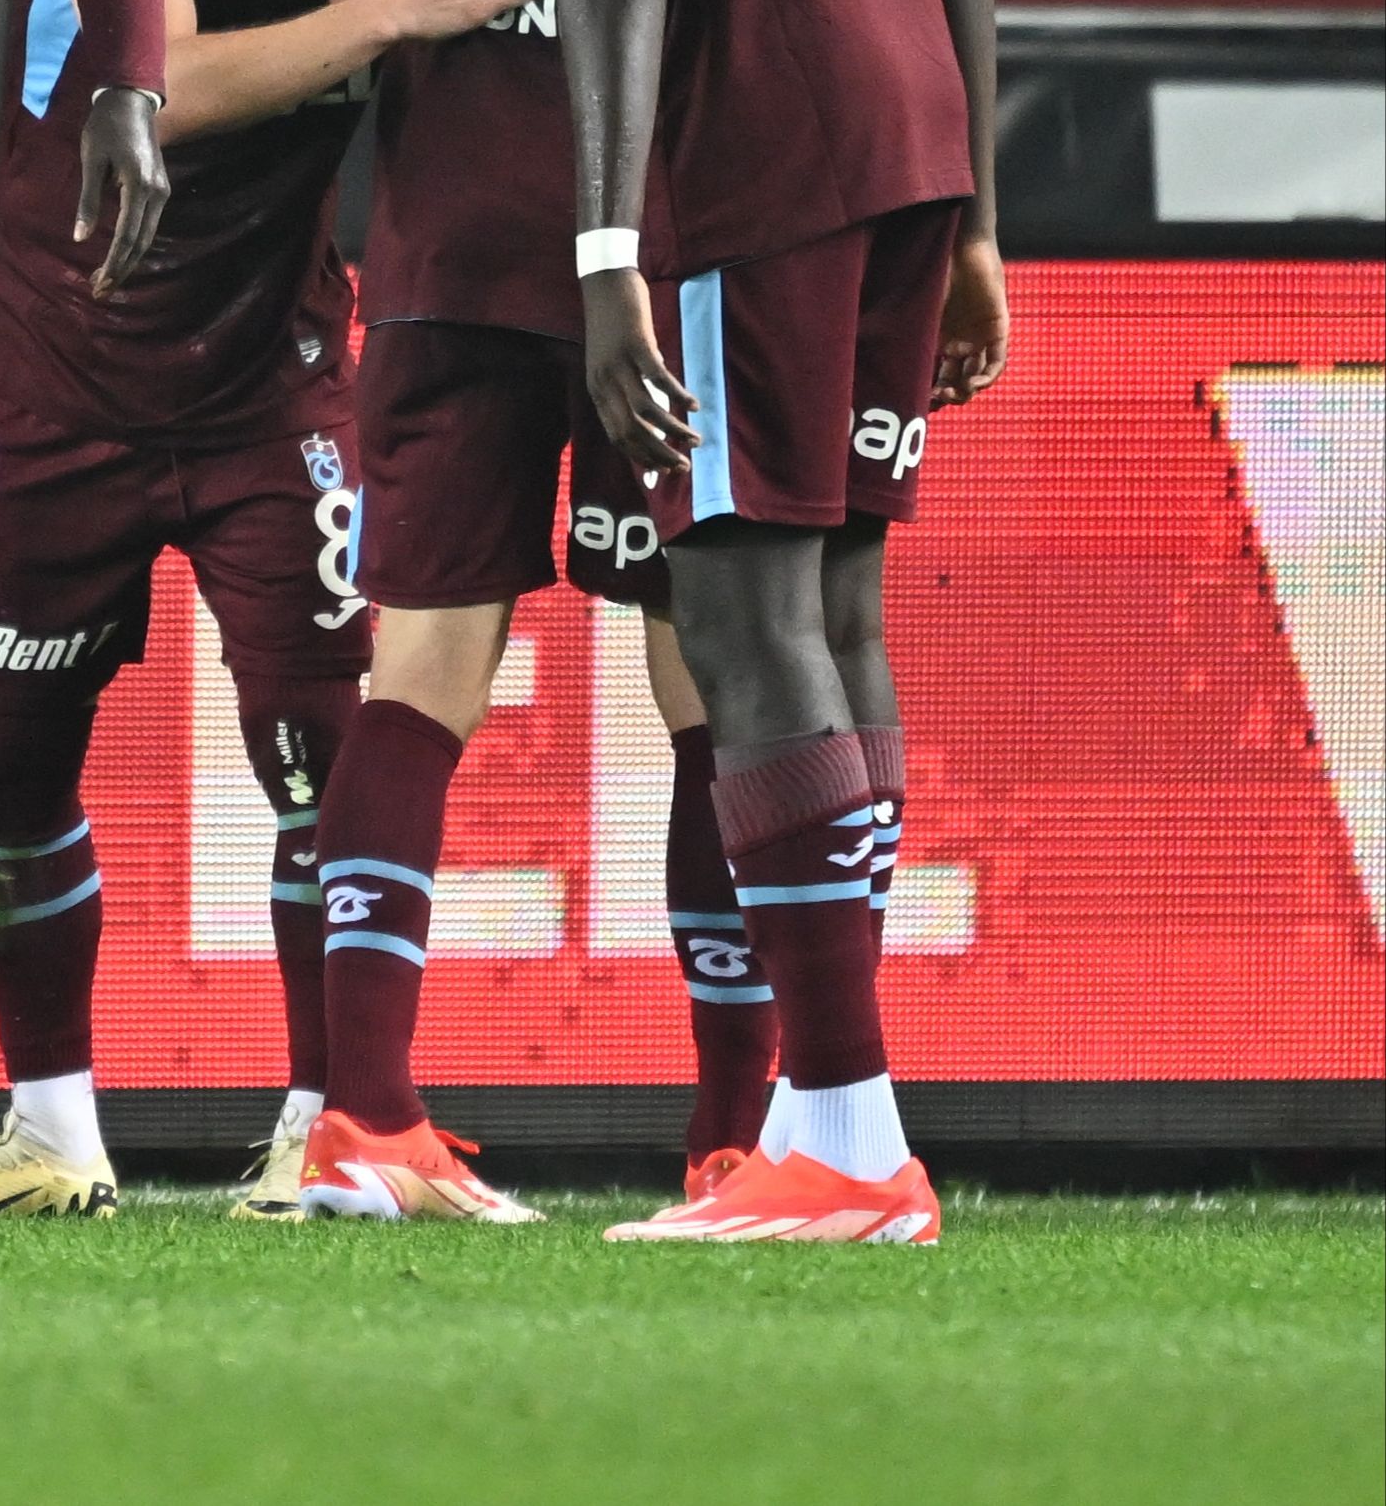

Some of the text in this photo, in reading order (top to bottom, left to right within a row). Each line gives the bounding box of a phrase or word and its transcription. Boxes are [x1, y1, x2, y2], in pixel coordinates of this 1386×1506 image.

[848, 407, 927, 481] ap
[314, 489, 360, 598] 8
[567, 504, 659, 570] ap
[275, 720, 294, 766] Miller
